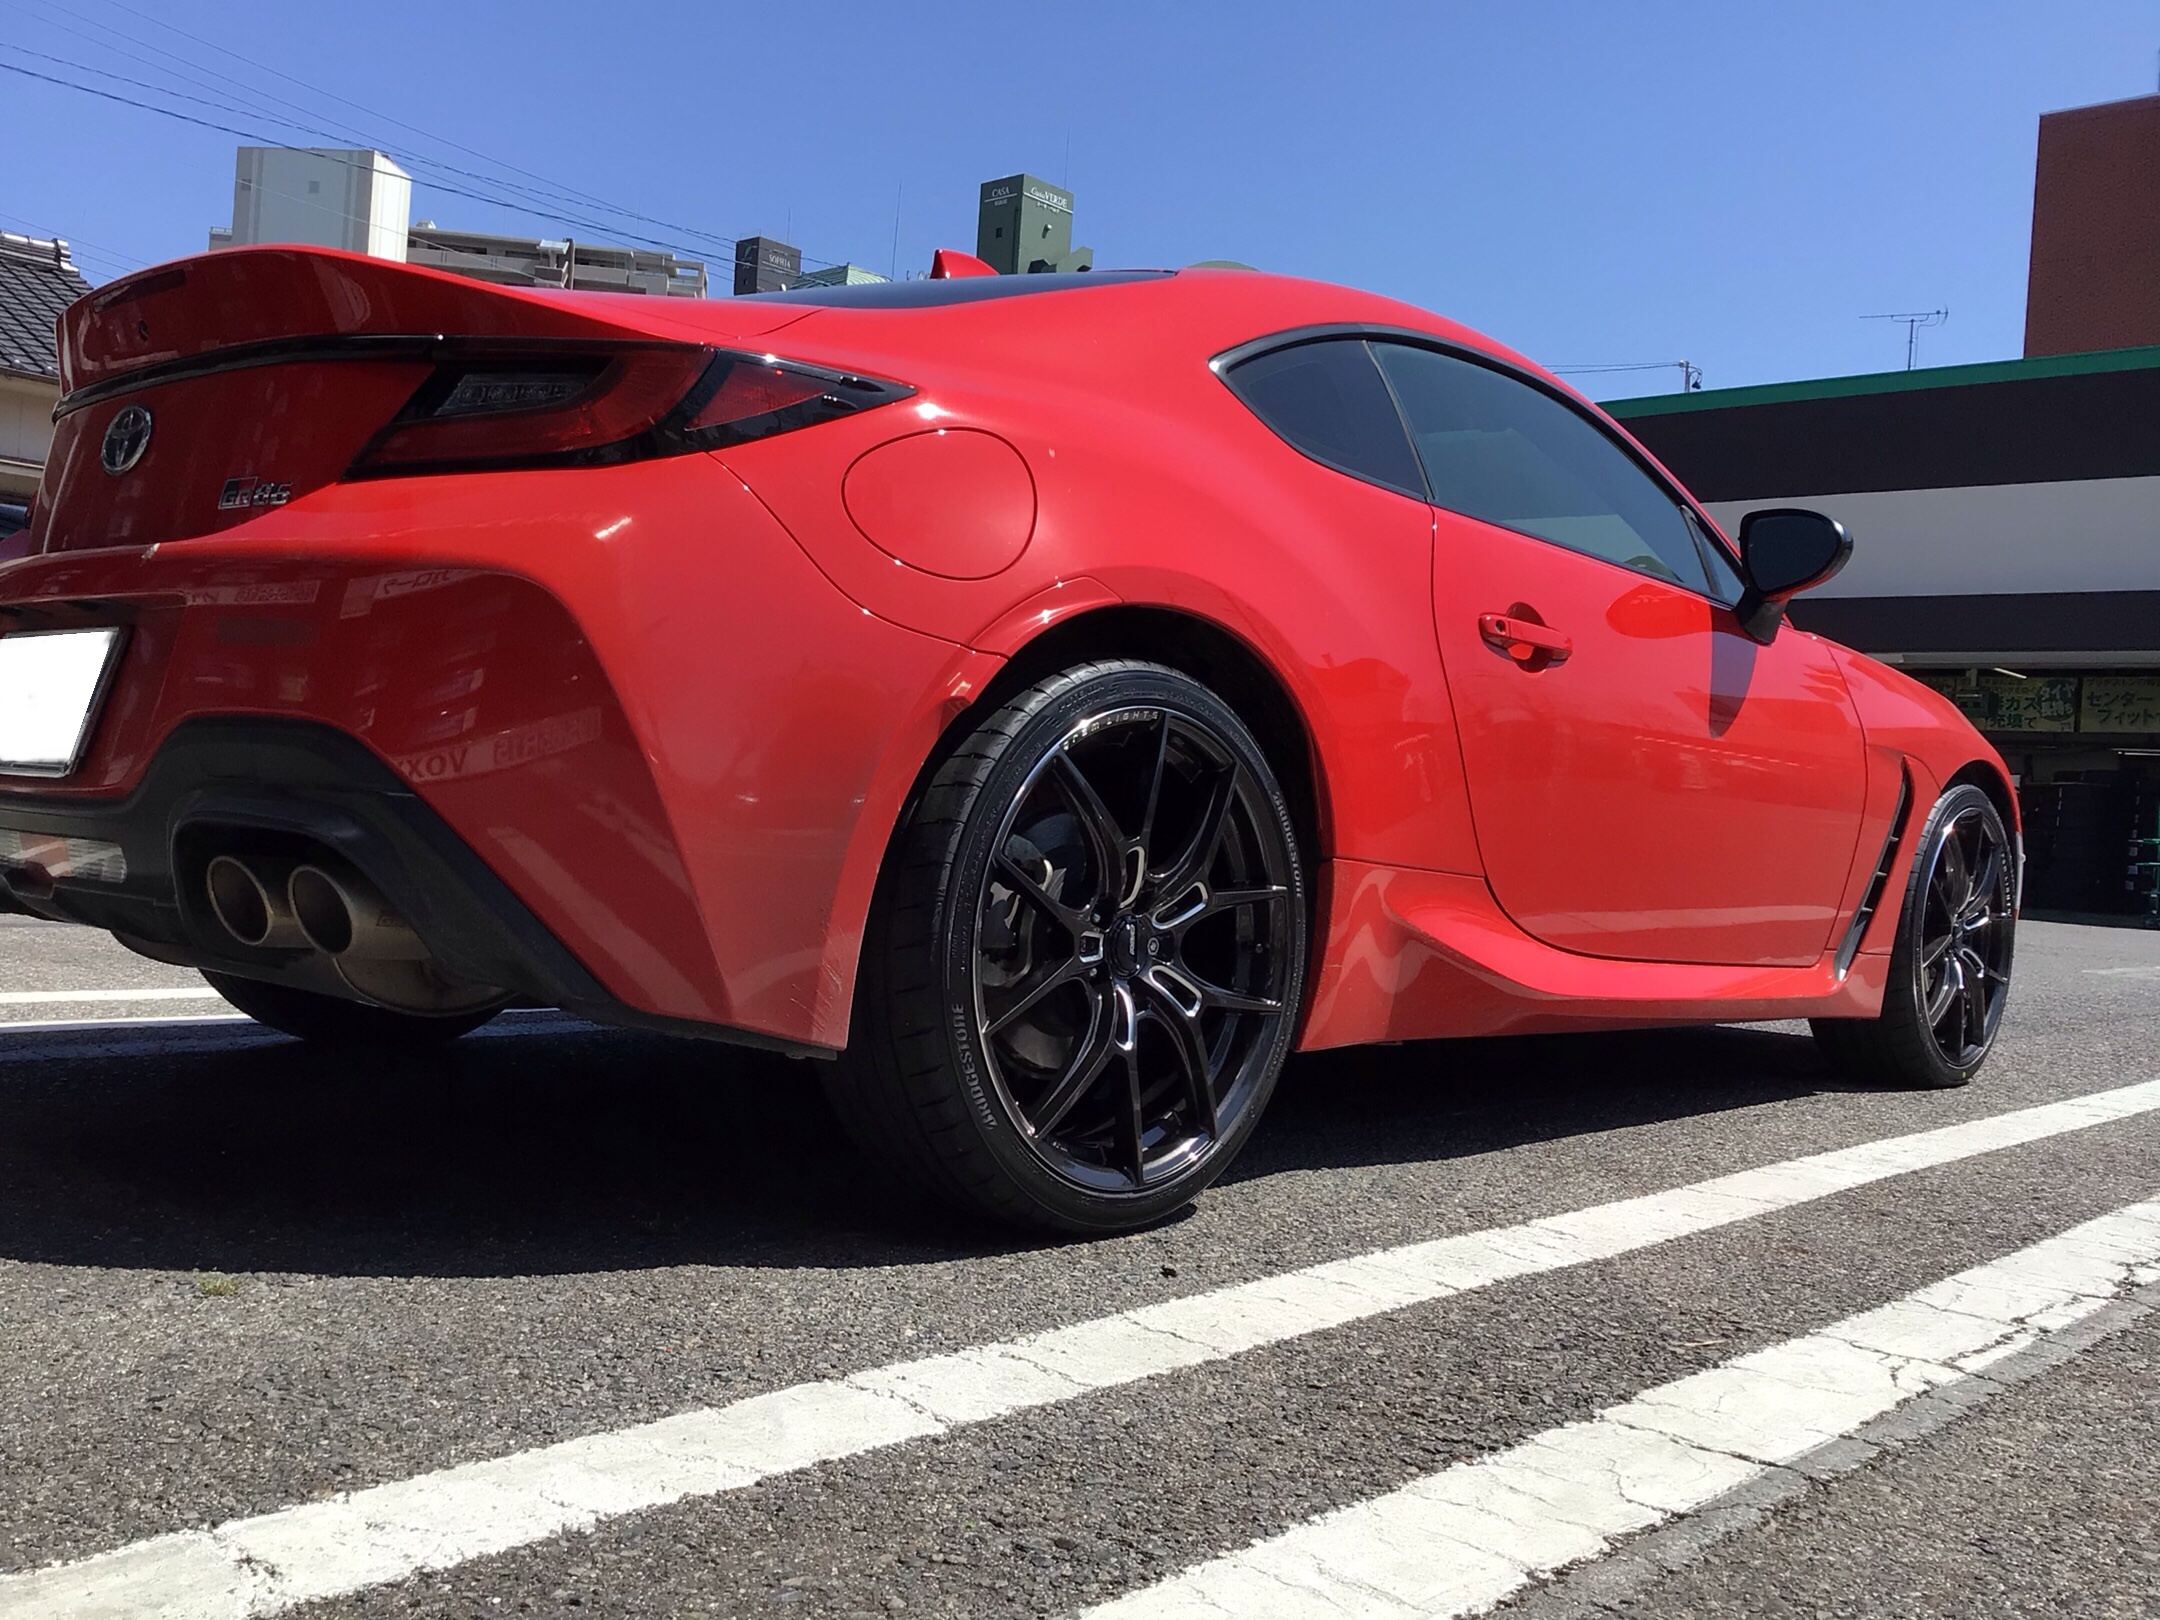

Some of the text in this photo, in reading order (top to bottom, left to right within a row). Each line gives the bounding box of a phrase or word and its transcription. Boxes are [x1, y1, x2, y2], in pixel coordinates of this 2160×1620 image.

[991, 186, 1010, 198] CASA
[1106, 710, 1159, 726] LIGHTS
[951, 1003, 998, 1130] BRIDGESTONE
